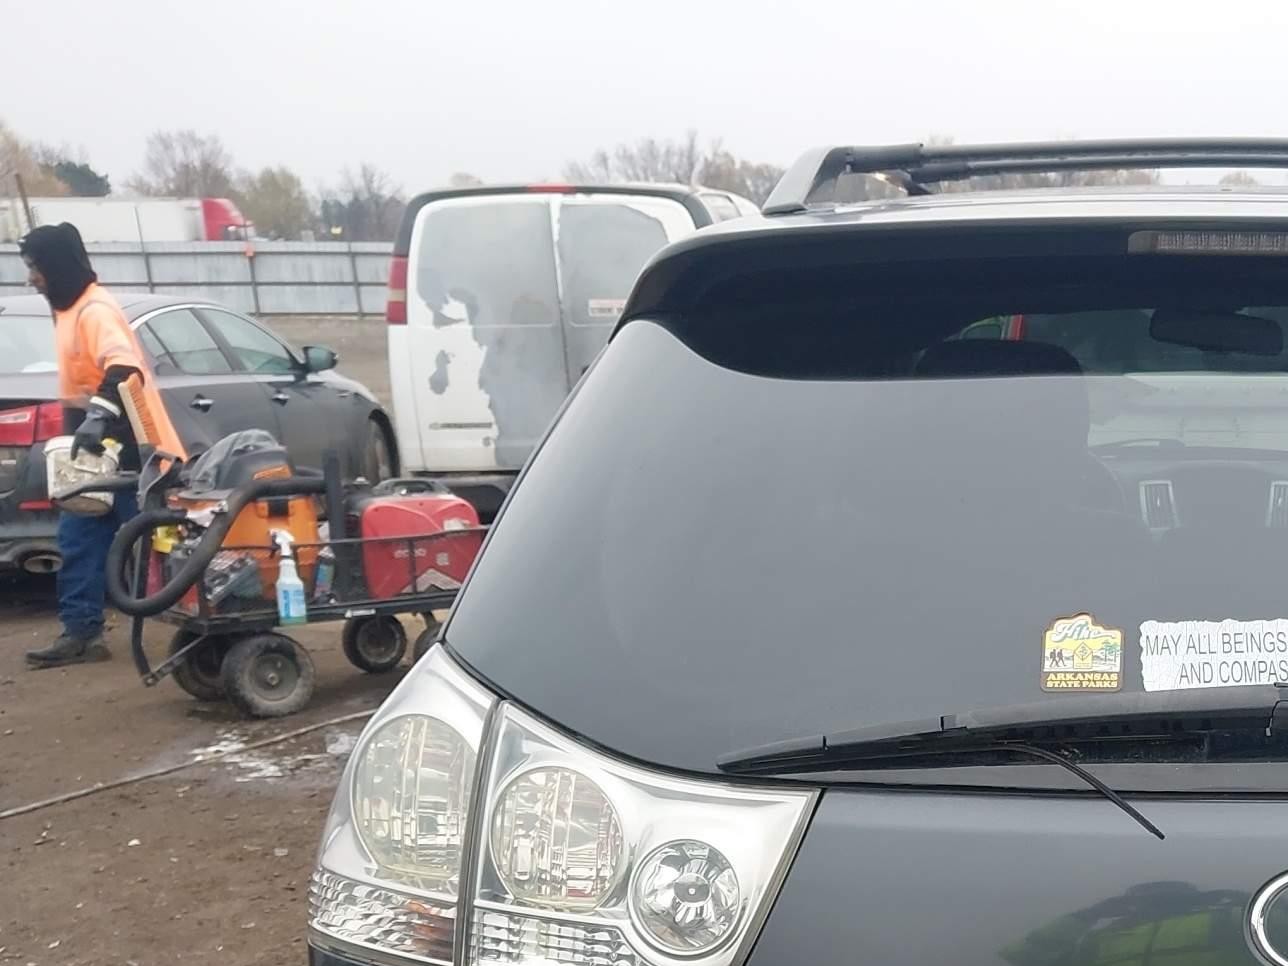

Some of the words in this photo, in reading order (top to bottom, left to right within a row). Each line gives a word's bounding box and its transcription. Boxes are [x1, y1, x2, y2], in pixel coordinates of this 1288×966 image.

[1145, 634, 1181, 656] MAY
[1186, 633, 1217, 655] ALL
[1221, 632, 1288, 654] BEINGS
[1046, 672, 1118, 681] ARKANSAS
[1179, 662, 1214, 684] AND
[1046, 680, 1080, 688] STATE
[1082, 680, 1118, 688] PARKS
